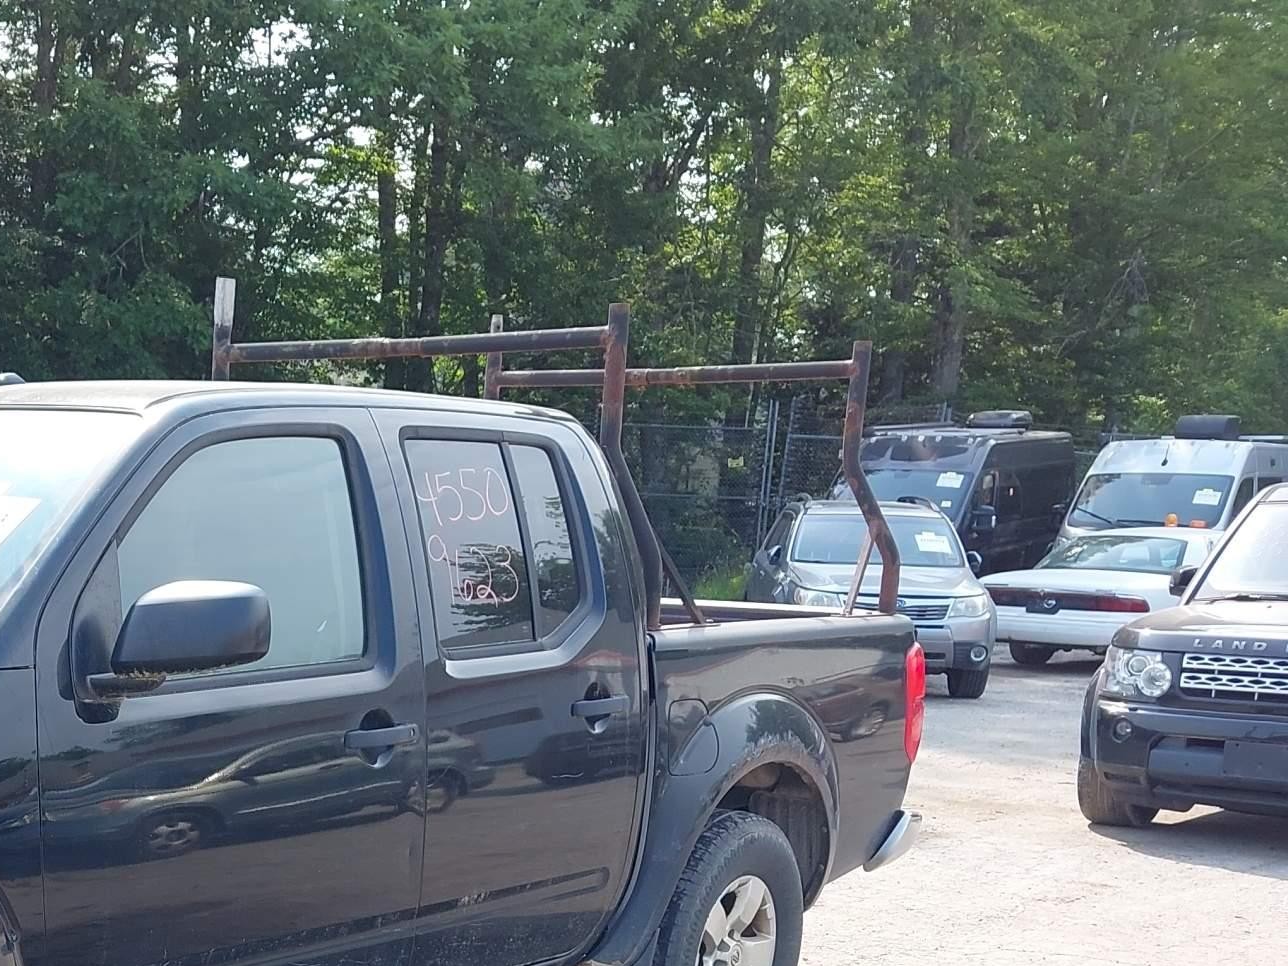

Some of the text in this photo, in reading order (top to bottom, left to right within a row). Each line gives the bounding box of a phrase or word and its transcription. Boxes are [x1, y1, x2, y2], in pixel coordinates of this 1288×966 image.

[417, 466, 509, 528] 4550
[428, 534, 519, 609] 9623
[1193, 639, 1267, 650] LAND
